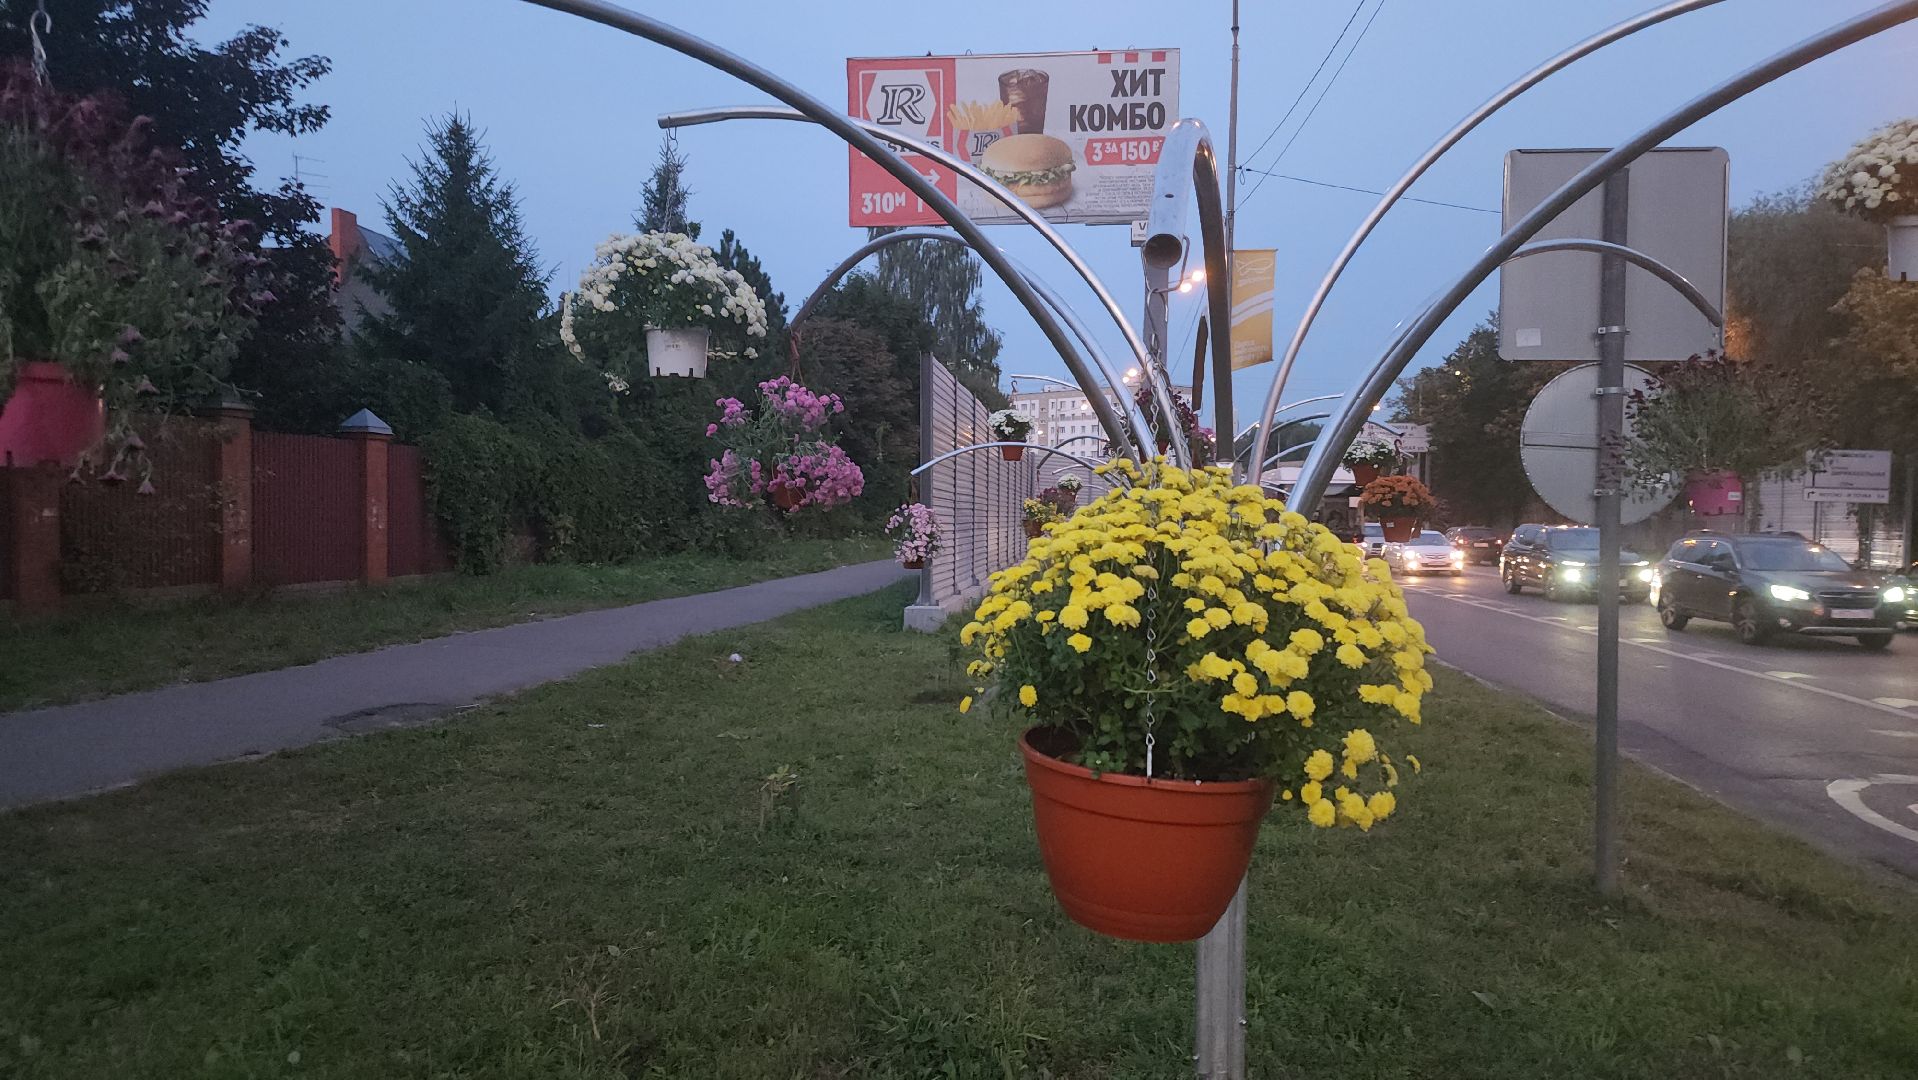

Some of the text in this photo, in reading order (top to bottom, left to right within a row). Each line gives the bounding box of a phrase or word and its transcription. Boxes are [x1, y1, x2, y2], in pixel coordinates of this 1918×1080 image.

[1110, 68, 1166, 98] ХИТ
[876, 83, 926, 125] R
[1069, 101, 1166, 133] КОМБО
